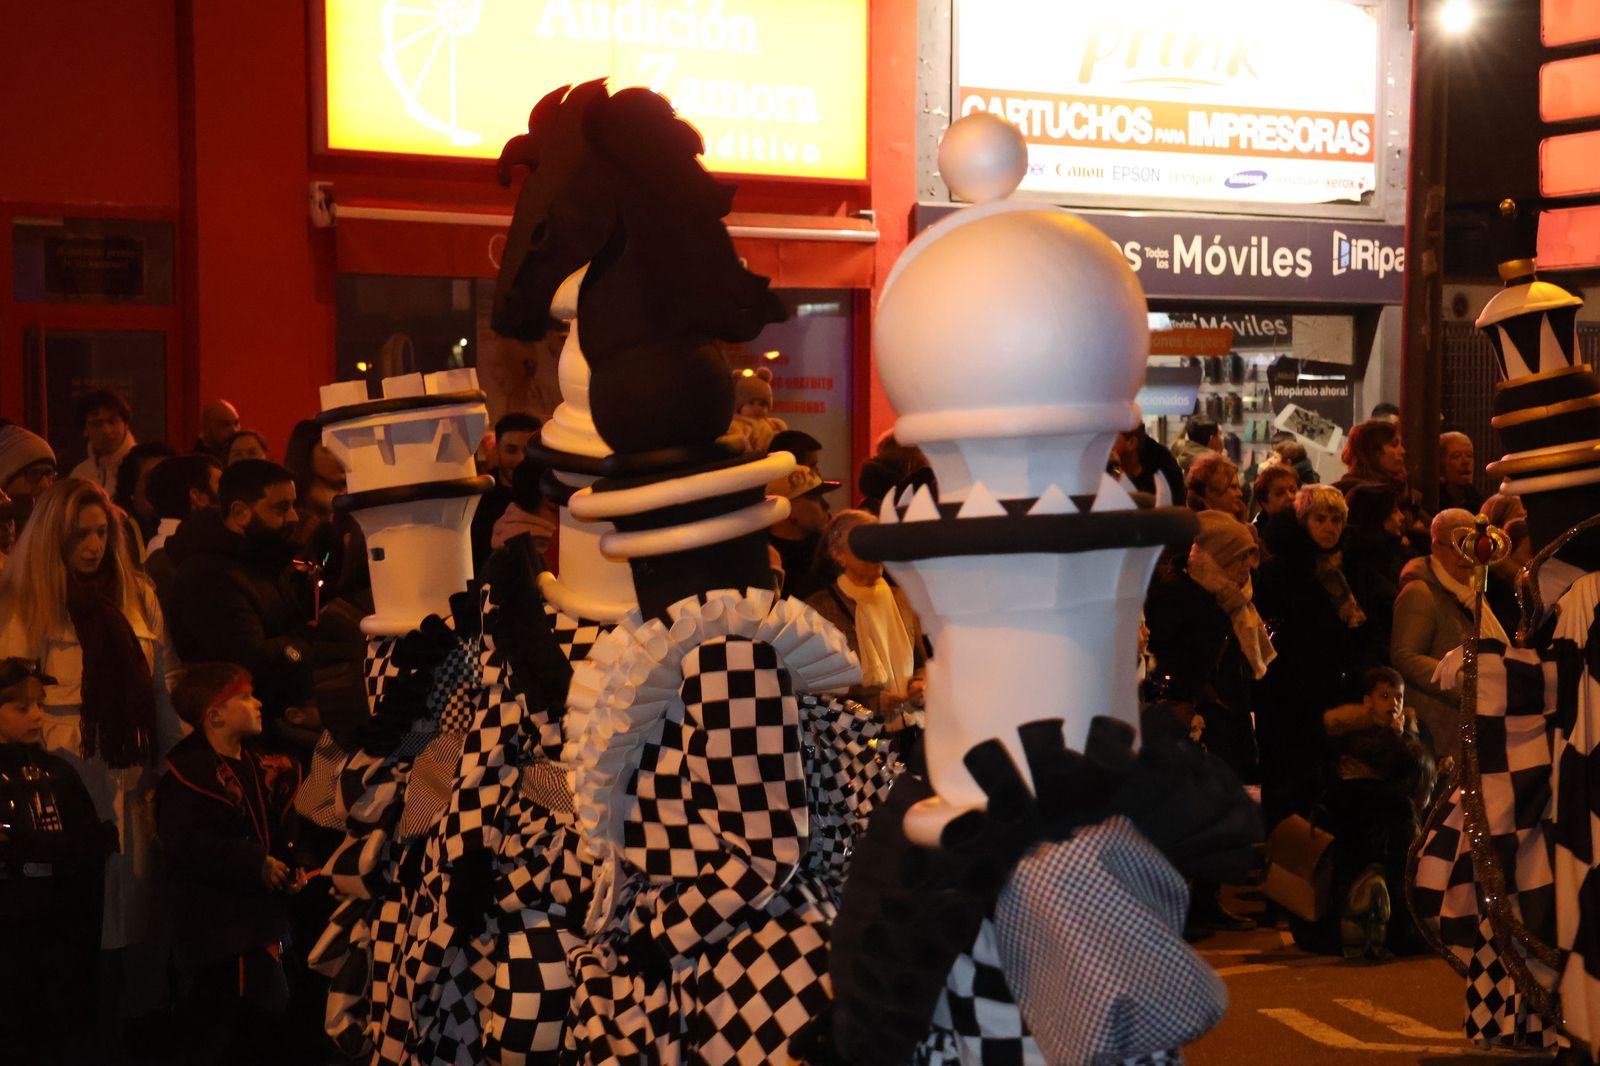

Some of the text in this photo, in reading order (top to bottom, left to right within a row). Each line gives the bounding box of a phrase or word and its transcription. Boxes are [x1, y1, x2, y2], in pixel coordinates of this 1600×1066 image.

[536, 0, 759, 52] Audición
[640, 54, 819, 122] Zamora
[1155, 128, 1185, 145] PARA
[1188, 111, 1370, 156] IMPRESORAS
[1056, 161, 1105, 178] Canon
[1113, 165, 1160, 183] EPSON
[1111, 239, 1142, 272] s
[1144, 246, 1169, 259] Todos
[1156, 258, 1169, 270] los
[1173, 234, 1313, 278] Móviles
[1319, 385, 1349, 398] ahora!
